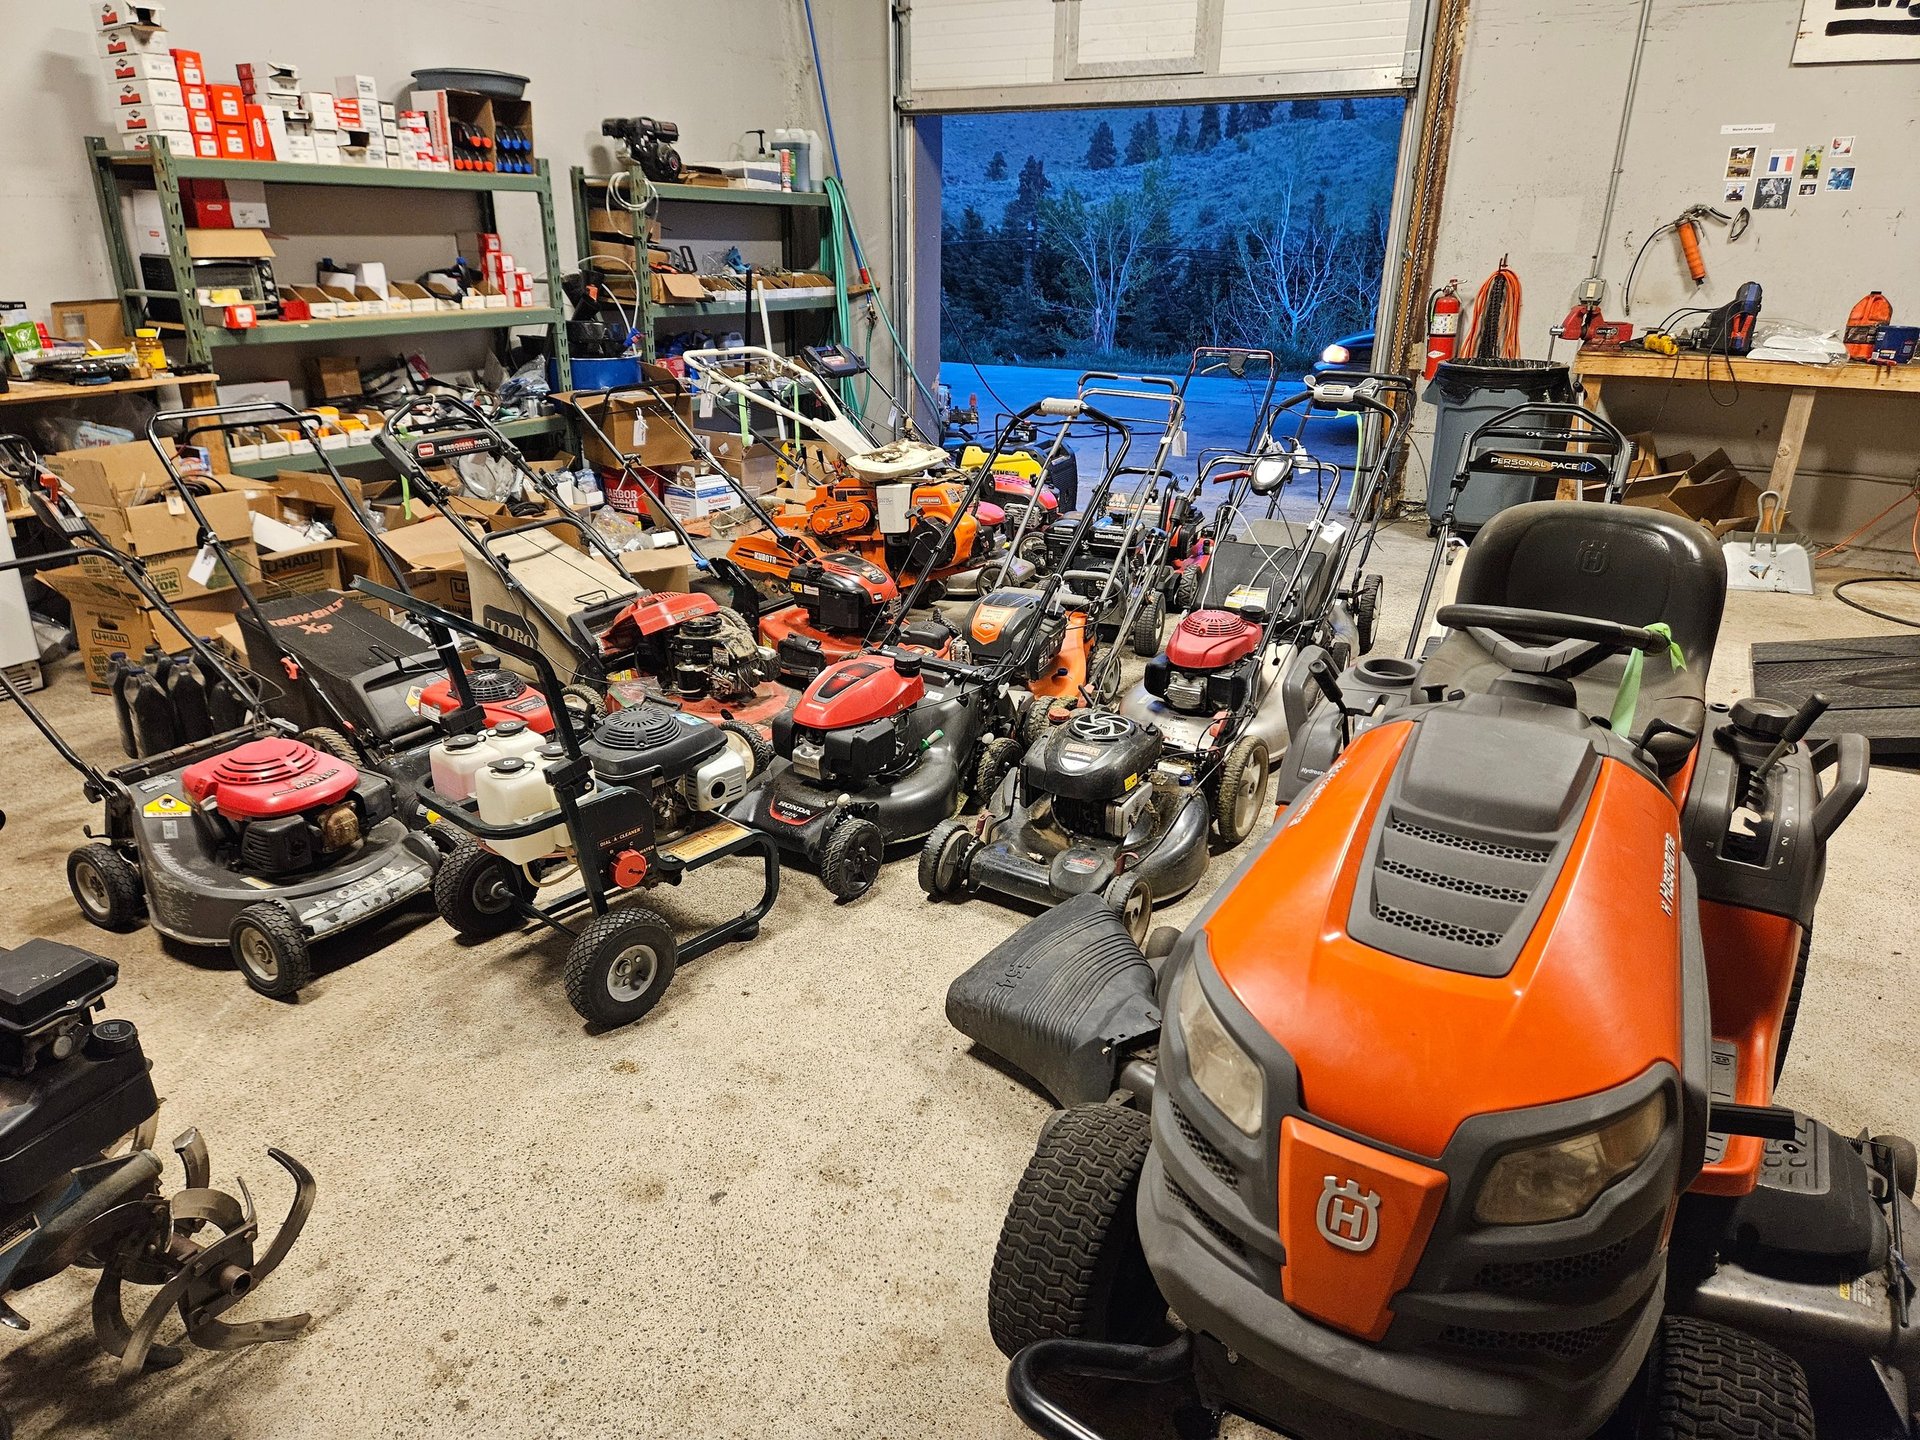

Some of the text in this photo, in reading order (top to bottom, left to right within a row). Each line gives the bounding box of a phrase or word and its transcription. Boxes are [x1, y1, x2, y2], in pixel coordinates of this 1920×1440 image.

[438, 441, 474, 451] PERSONAL
[1490, 457, 1547, 469] PERSONAL
[1550, 461, 1578, 471] PACE
[754, 551, 777, 565] KUBOTA
[158, 578, 179, 591] OK
[94, 631, 128, 643] U-HAUL
[486, 617, 534, 648] TORO
[777, 800, 811, 816] HONDA
[1659, 833, 1677, 906] Husqvarna
